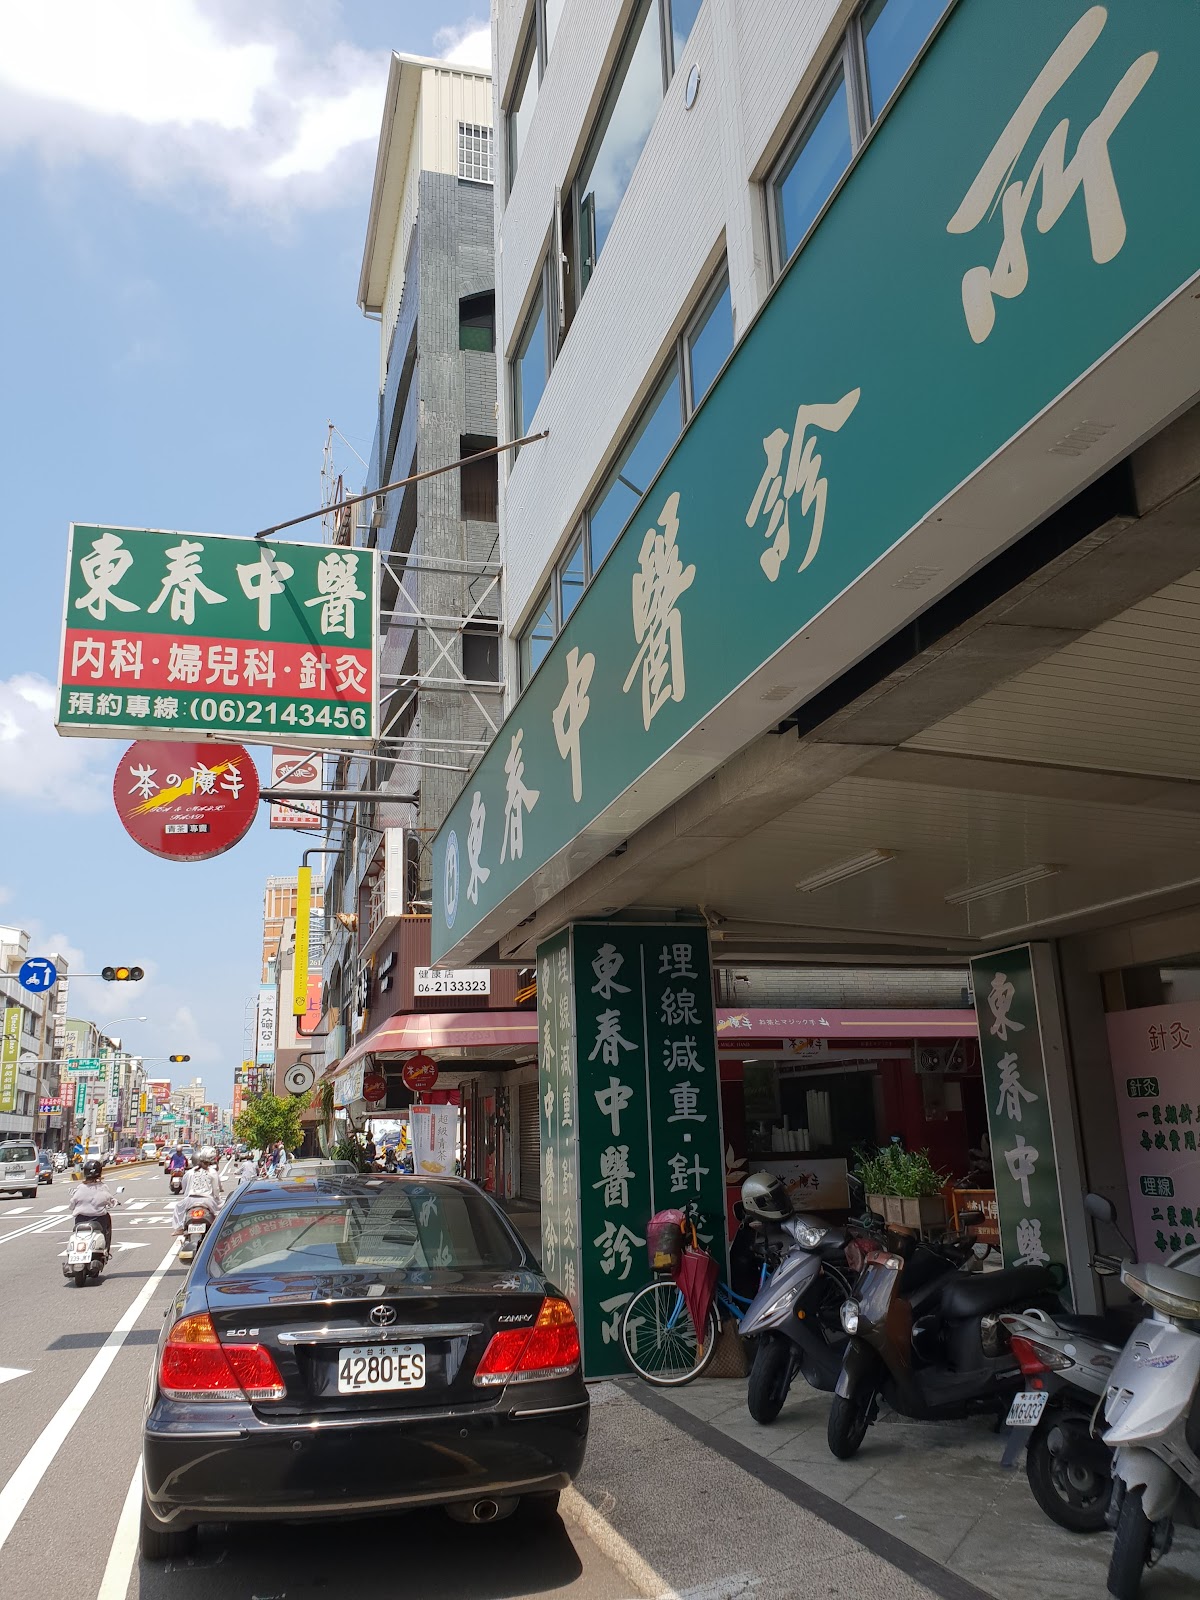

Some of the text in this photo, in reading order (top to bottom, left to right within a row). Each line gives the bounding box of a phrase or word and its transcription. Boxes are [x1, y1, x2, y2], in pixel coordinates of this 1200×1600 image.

[465, 4, 1160, 904] 東春中醫診所
[75, 532, 367, 640] 東春中醫
[127, 760, 245, 800] 茶の魔手
[418, 969, 454, 979] 健康店
[418, 980, 487, 993] 06-2133323
[1147, 1021, 1193, 1052] 針灸
[1129, 1078, 1158, 1097] 針灸
[437, 1113, 449, 1162] 超級青茶
[588, 943, 648, 1354] 東春中醫診所
[1143, 1177, 1172, 1197] 埋線
[366, 1346, 399, 1356] 台北市
